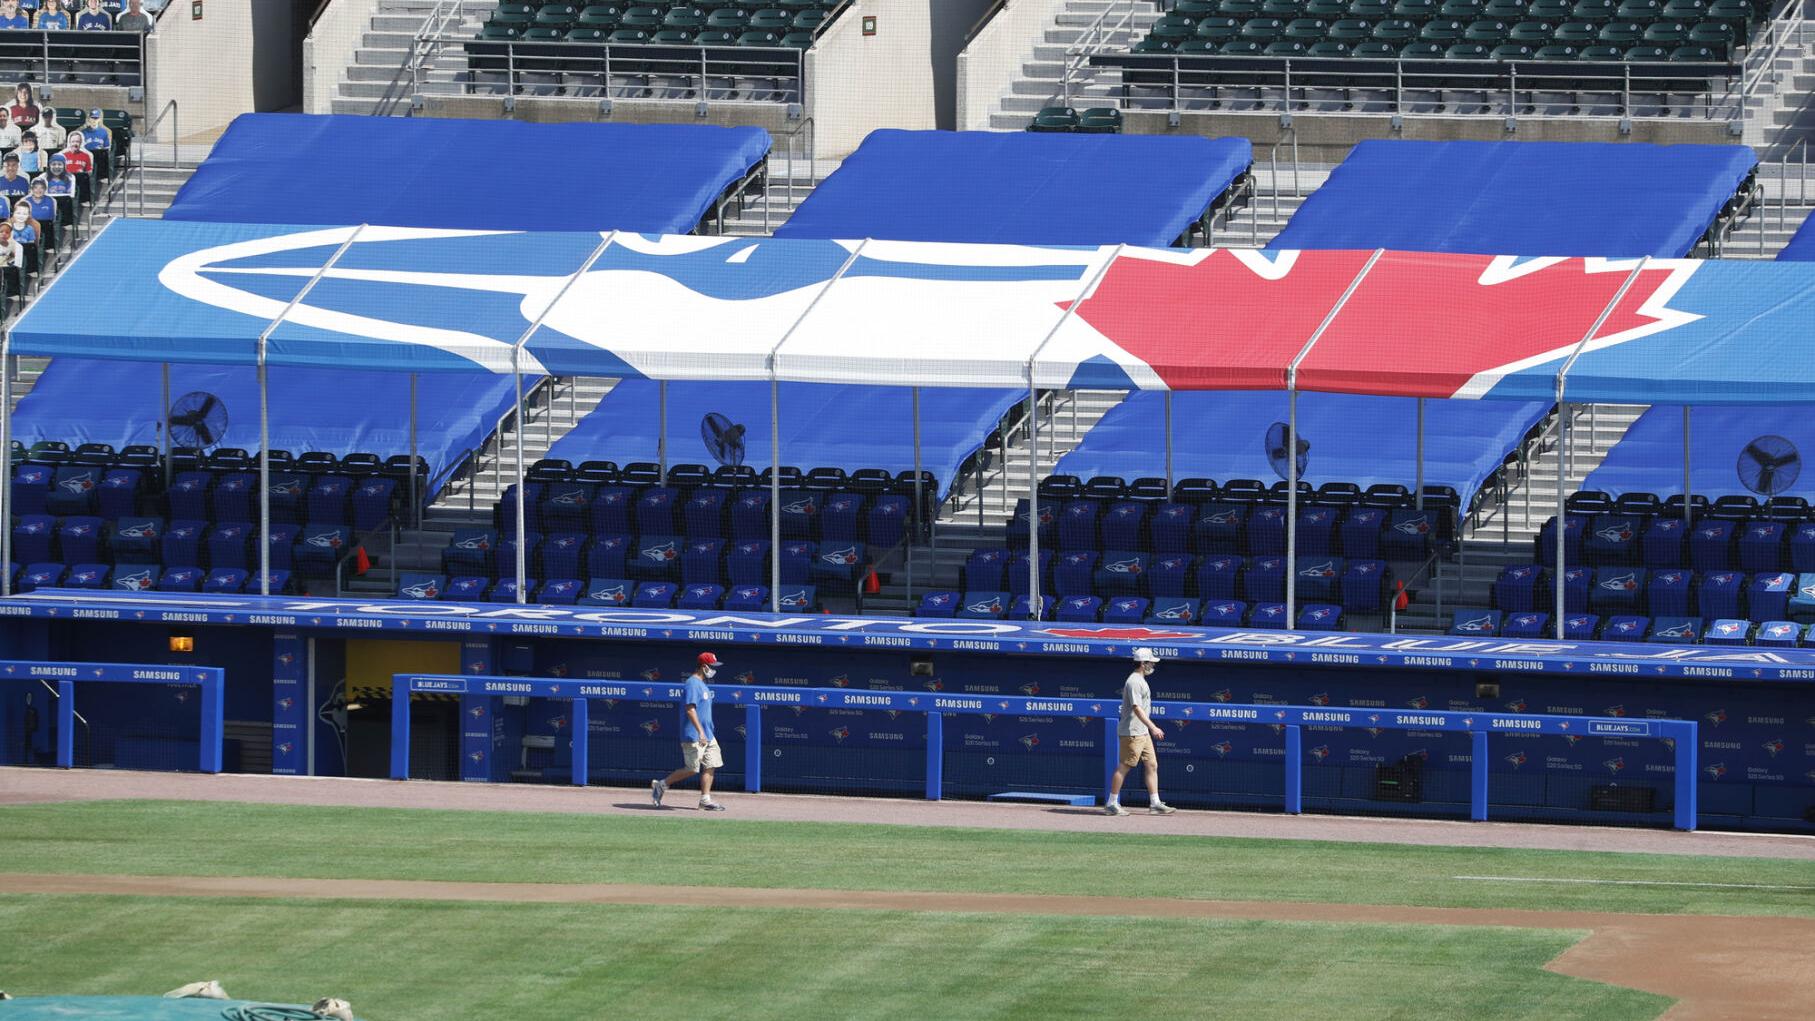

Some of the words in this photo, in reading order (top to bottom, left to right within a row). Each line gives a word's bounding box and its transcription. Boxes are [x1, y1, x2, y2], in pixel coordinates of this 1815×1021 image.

[73, 609, 118, 618] SAMSUNG
[162, 612, 208, 622] SAMSUNG
[250, 615, 295, 624] SAMSUNG
[337, 618, 382, 627] SAMSUNG
[425, 621, 471, 630] SAMSUNG
[512, 624, 558, 633] SAMSUNG
[601, 627, 647, 637] SAMSUNG
[688, 630, 734, 640] SAMSUNG
[776, 634, 822, 644] SAMSUNG
[864, 636, 911, 646] SAMSUNG
[953, 640, 999, 650] SAMSUNG
[1042, 643, 1089, 653] SAMSUNG
[1132, 647, 1178, 657] SSUNG
[1221, 650, 1268, 660] SAMSUNG
[1311, 653, 1359, 663] SAMSUNG
[1404, 656, 1452, 666] SAMSUNG
[1496, 660, 1544, 670] SAMSUNG
[1590, 663, 1639, 673] SAMSUNG
[31, 667, 77, 676] SAMSUNG
[133, 670, 180, 680] SAMSUNG
[1683, 667, 1732, 677] SAMSUNG
[486, 682, 532, 692] SAMSUNG
[580, 686, 627, 695] SAMSUNG
[754, 692, 801, 702] SAMSUNG
[844, 695, 891, 705] SAMSUNG
[935, 699, 982, 709] SAMSUNG
[1026, 702, 1073, 711] SAMSUNG
[1210, 709, 1257, 718] SAMSUNG
[1302, 712, 1350, 721] SAMSUNG
[1396, 715, 1445, 725] SAMSUNG
[1492, 719, 1540, 729] SAMSUNG
[1253, 747, 1286, 755] SAMSUN
